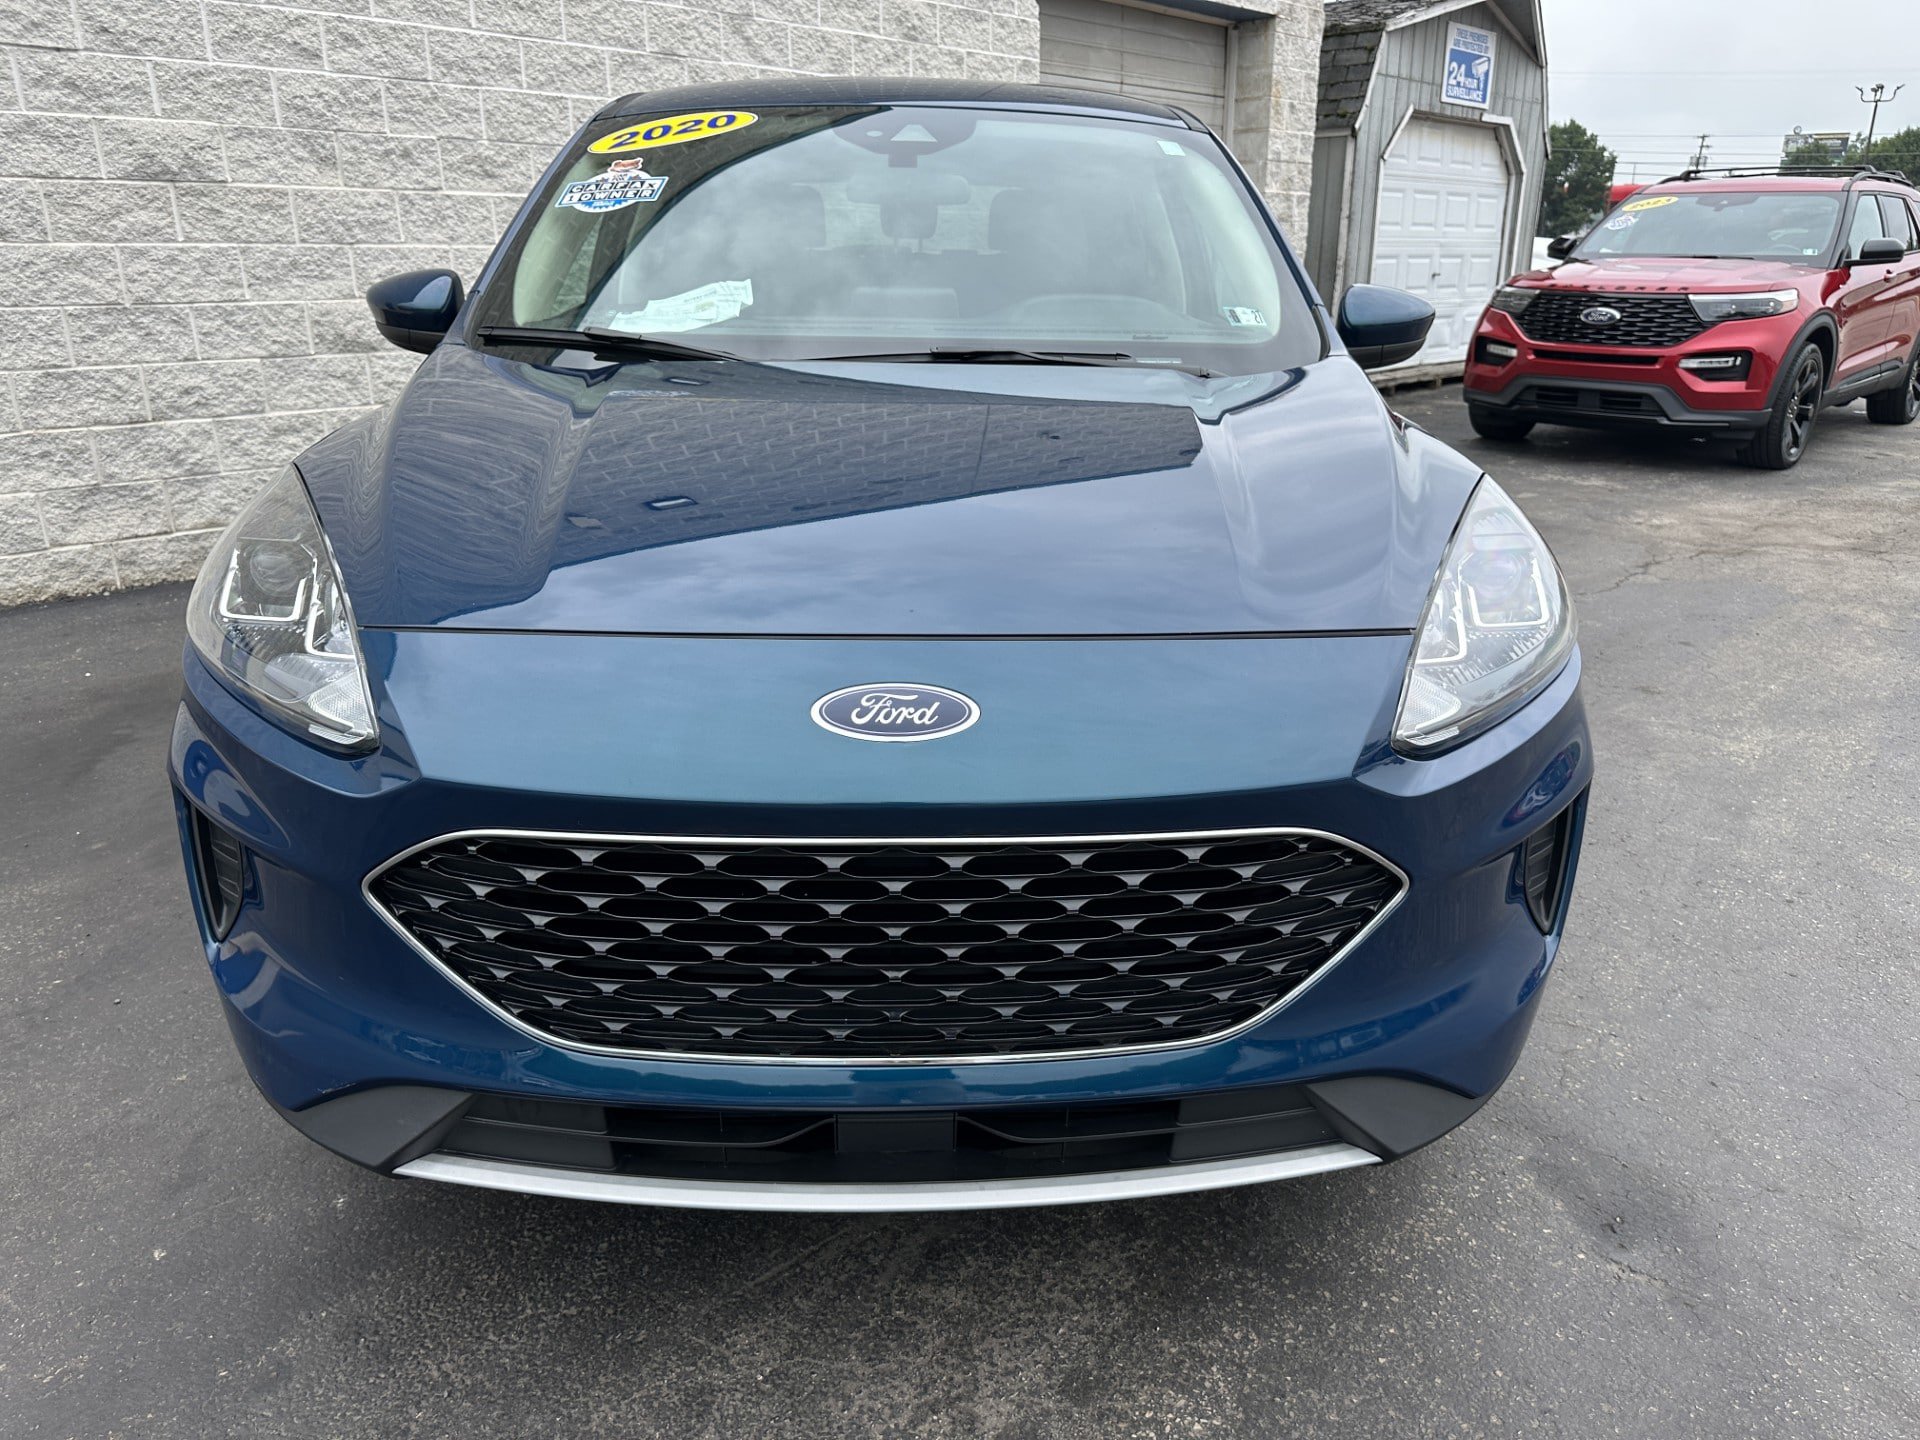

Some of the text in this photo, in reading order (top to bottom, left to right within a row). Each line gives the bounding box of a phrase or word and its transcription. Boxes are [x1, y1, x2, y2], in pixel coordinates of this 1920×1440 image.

[1449, 62, 1478, 89] 24 HOUR
[1447, 86, 1483, 102] SURVEILLANCE
[608, 114, 736, 150] 2020
[569, 180, 658, 193] CARFAX
[580, 189, 656, 201] OWNER
[850, 692, 941, 725] Ford
